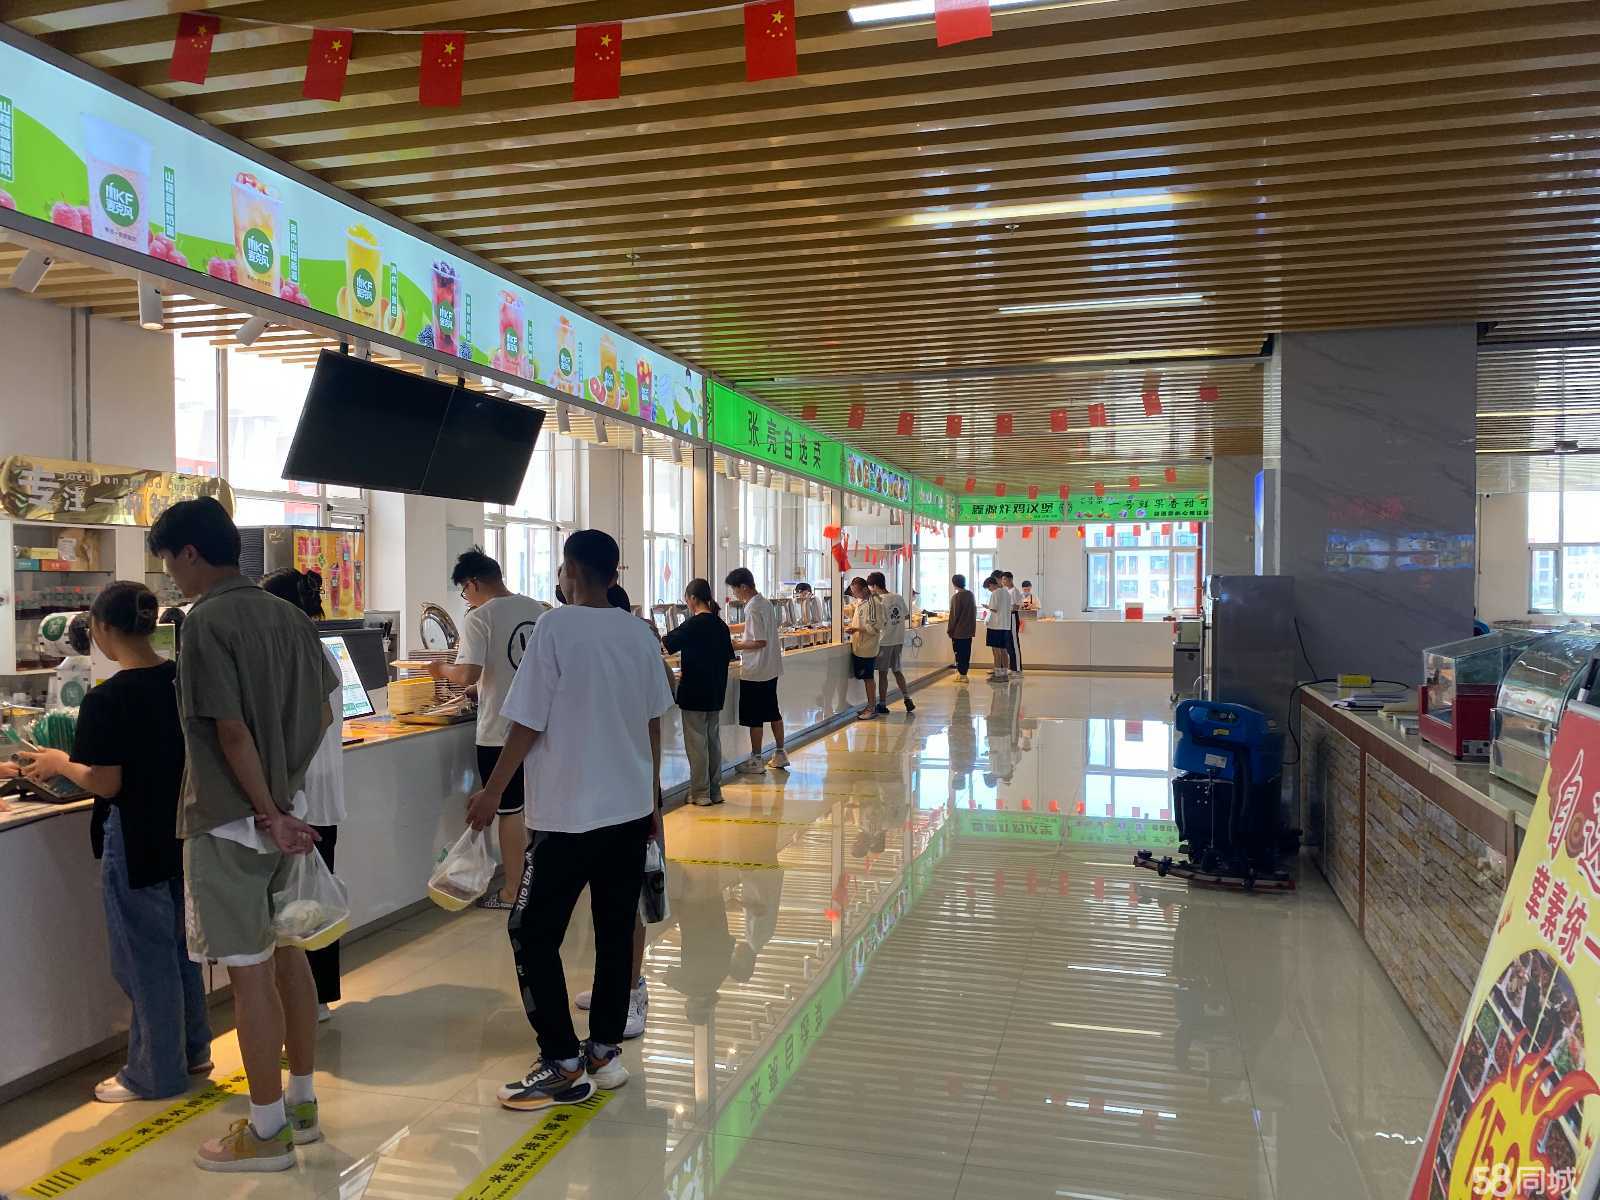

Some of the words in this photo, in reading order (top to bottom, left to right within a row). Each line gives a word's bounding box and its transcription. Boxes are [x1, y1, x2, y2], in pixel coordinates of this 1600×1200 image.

[748, 409, 822, 470] 张亮自选菜
[1525, 864, 1600, 963] 荤素统一
[466, 1113, 572, 1200] 一米线外排队等候
